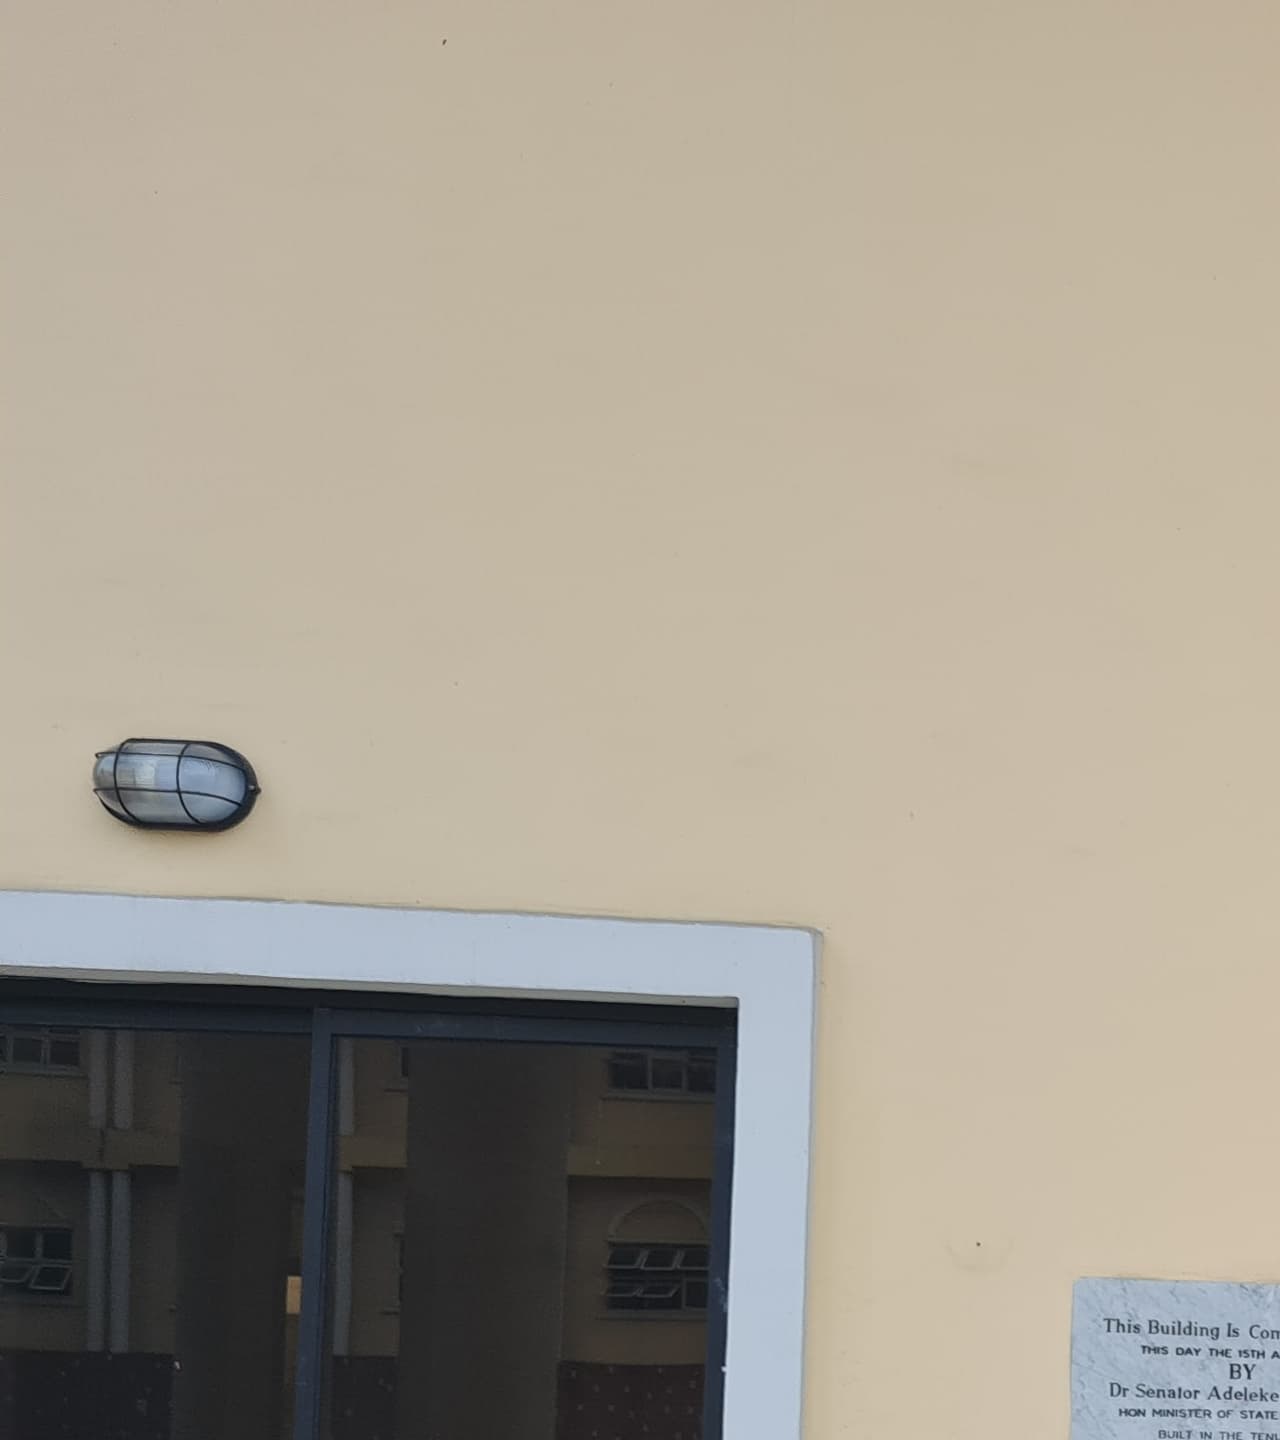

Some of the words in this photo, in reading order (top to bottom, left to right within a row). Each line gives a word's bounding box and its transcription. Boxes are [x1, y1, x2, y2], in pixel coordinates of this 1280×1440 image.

[1104, 1318, 1141, 1334] This
[1148, 1319, 1220, 1340] Building
[1227, 1322, 1240, 1337] Is
[1141, 1345, 1168, 1355] THIS
[1176, 1347, 1201, 1356] DAY
[1209, 1348, 1232, 1358] THE
[1239, 1349, 1265, 1359] 15TH
[1230, 1363, 1256, 1380] BY
[1109, 1382, 1129, 1397] Dr
[1136, 1384, 1200, 1399] Senator
[1208, 1385, 1279, 1402] Adeleke
[1119, 1408, 1146, 1417] HON
[1152, 1409, 1211, 1418] MINISTER
[1217, 1410, 1234, 1419] OF
[1240, 1410, 1278, 1420] STATE
[1158, 1430, 1192, 1439] BUILT
[1200, 1431, 1212, 1439] IN
[1219, 1432, 1243, 1440] THE
